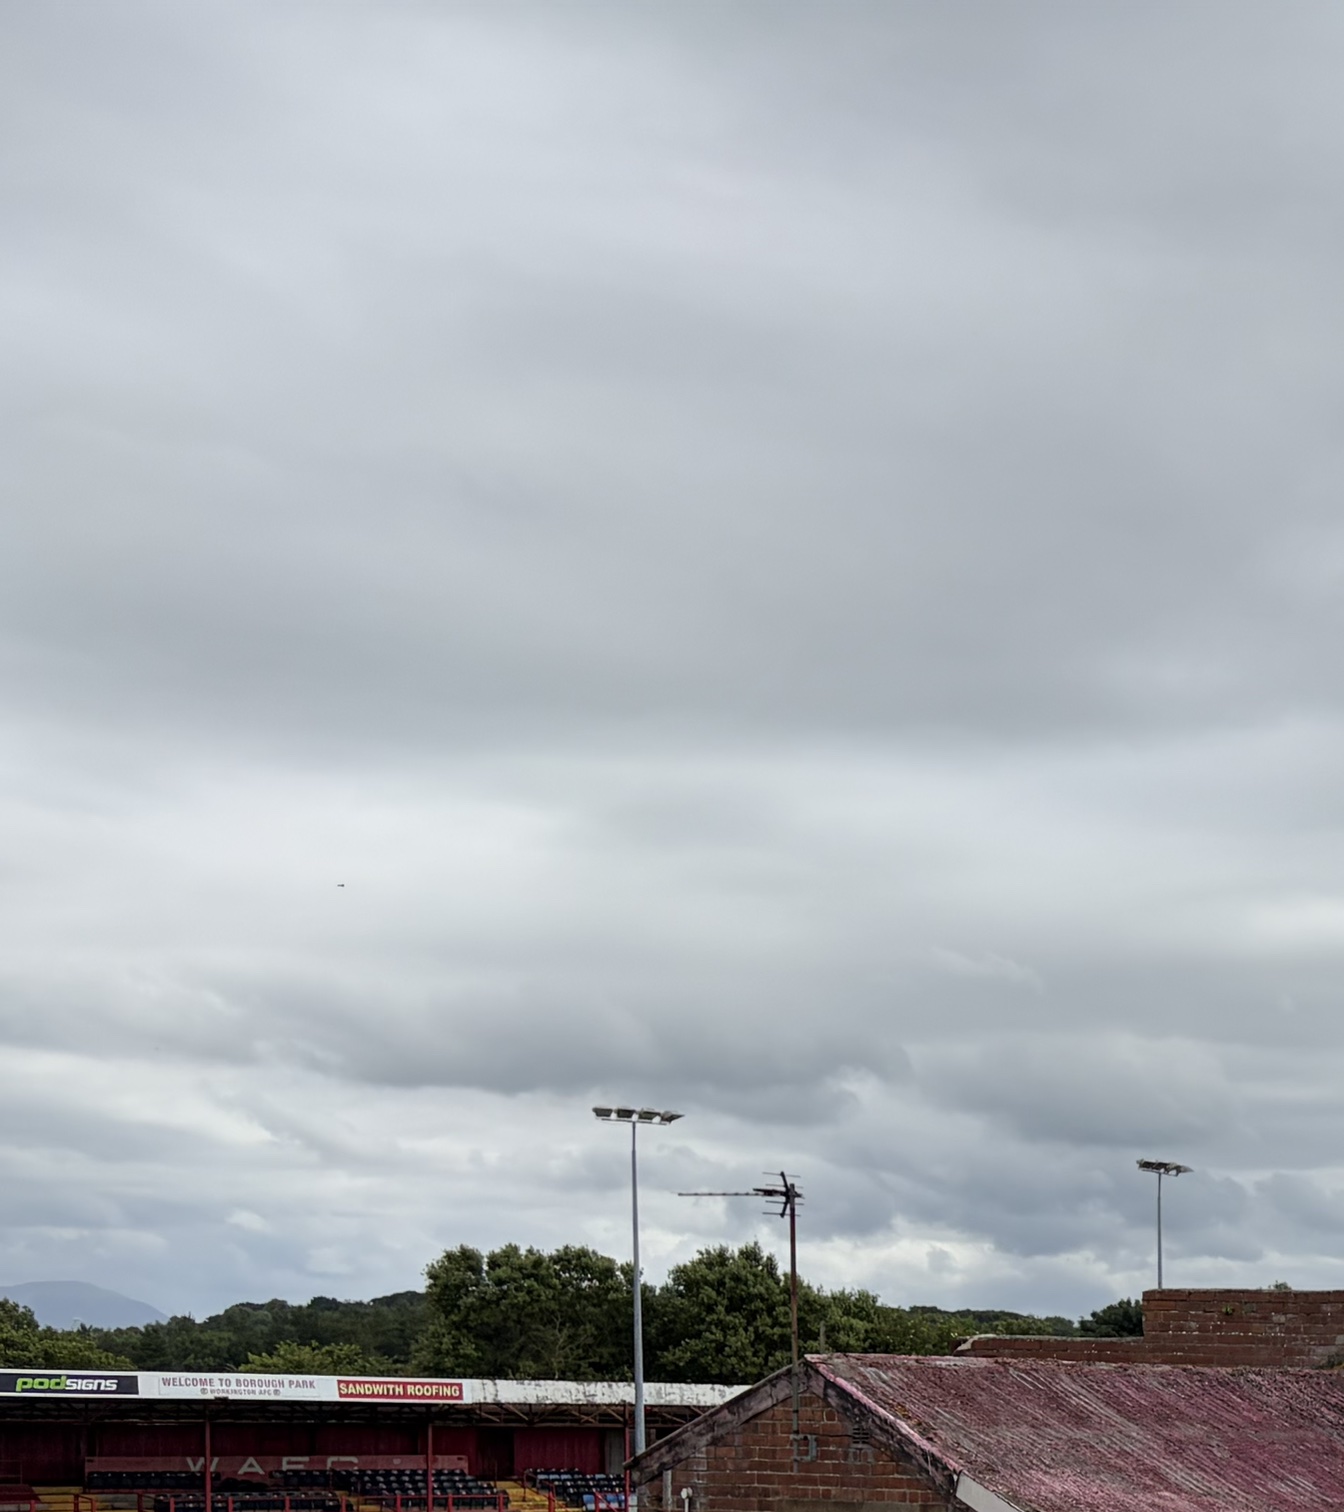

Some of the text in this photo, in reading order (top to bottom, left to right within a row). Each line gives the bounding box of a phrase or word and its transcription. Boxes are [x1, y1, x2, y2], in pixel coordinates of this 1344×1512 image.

[162, 1377, 316, 1389] WELCOME TO BOROUGH PARK
[340, 1383, 460, 1397] SANDWITH ROOFING
